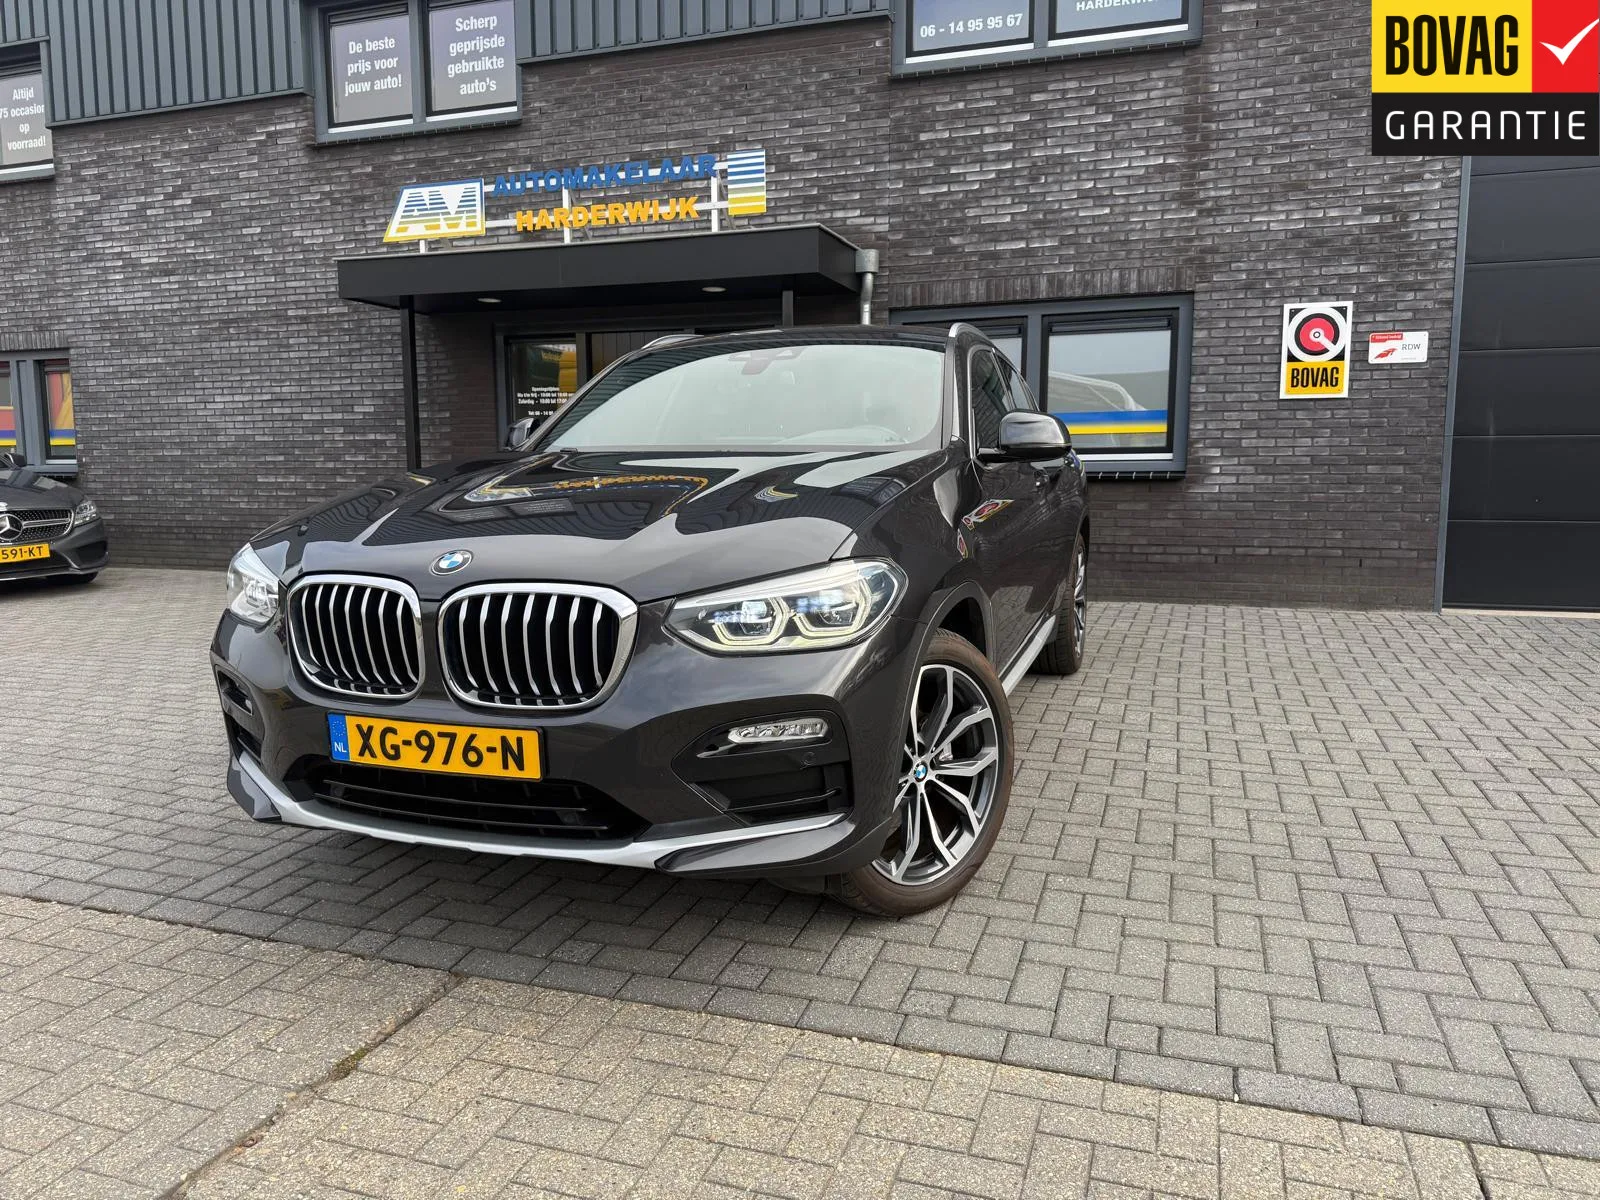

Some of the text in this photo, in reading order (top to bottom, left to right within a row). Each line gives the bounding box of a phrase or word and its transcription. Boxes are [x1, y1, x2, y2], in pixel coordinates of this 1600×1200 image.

[455, 15, 498, 32] Scherp
[920, 24, 935, 38] 06
[948, 22, 964, 34] 14
[967, 20, 983, 32] 95
[986, 17, 1002, 30] 95
[1006, 14, 1023, 27] 67
[348, 37, 396, 54] De beste
[449, 34, 505, 57] geprijsde
[347, 56, 399, 76] prijs voor
[447, 56, 504, 78] gebruikte
[12, 87, 35, 101] Altijd
[344, 74, 402, 97] jouw auto!
[460, 79, 497, 96] auto's
[19, 122, 30, 134] op
[7, 135, 46, 151] voorraad!
[492, 154, 718, 197] AUTOMAKELAAR
[515, 196, 699, 232] HARDERWIJK
[1401, 343, 1421, 351] RDW
[1290, 366, 1340, 388] BOVAG
[1, 546, 44, 560] 591-KT
[334, 723, 525, 771] NL XG-976-N
